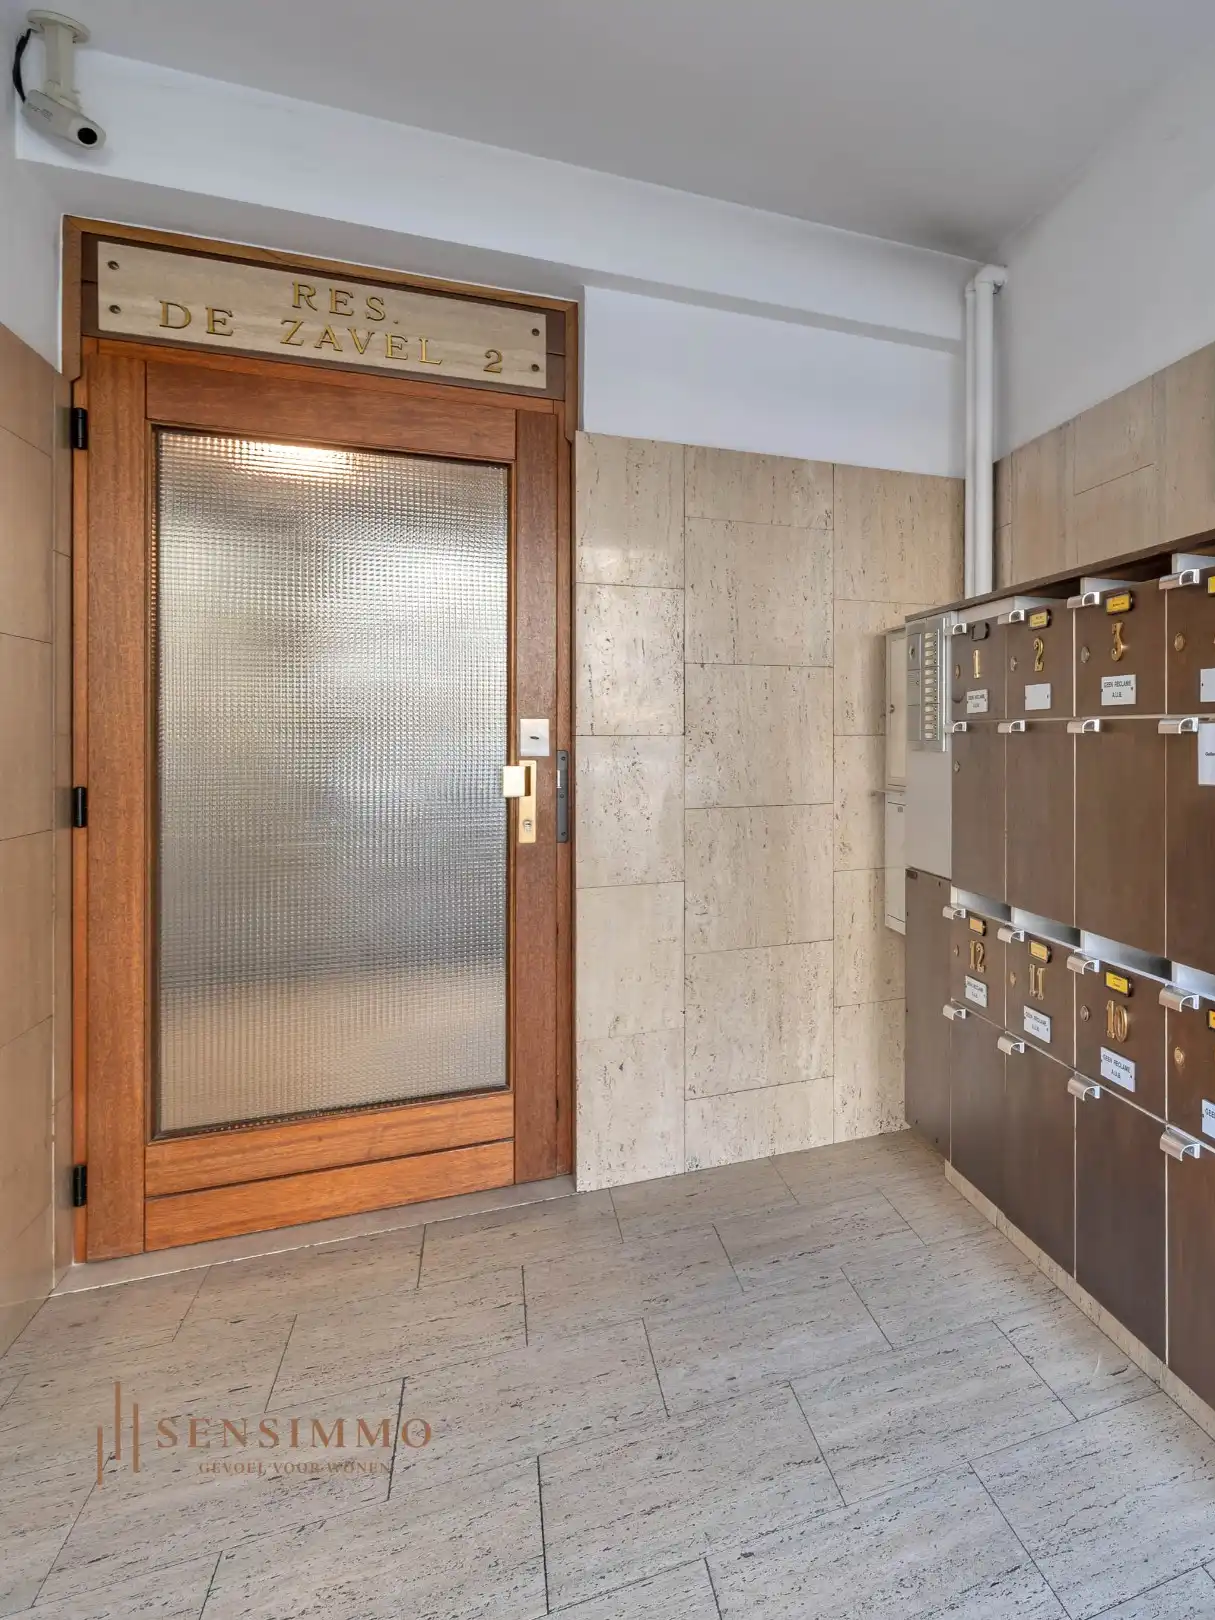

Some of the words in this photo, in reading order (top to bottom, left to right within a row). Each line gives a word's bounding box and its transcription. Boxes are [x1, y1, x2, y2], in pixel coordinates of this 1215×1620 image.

[291, 281, 399, 324] RES.
[158, 300, 234, 336] DE
[280, 319, 443, 365] ZAVEL
[484, 349, 504, 373] 2
[1033, 637, 1045, 672] 2
[1110, 622, 1124, 661] 3
[973, 650, 981, 679] 1
[969, 940, 985, 973] 12
[1029, 963, 1045, 1000] 11
[1106, 1000, 1129, 1043] 10
